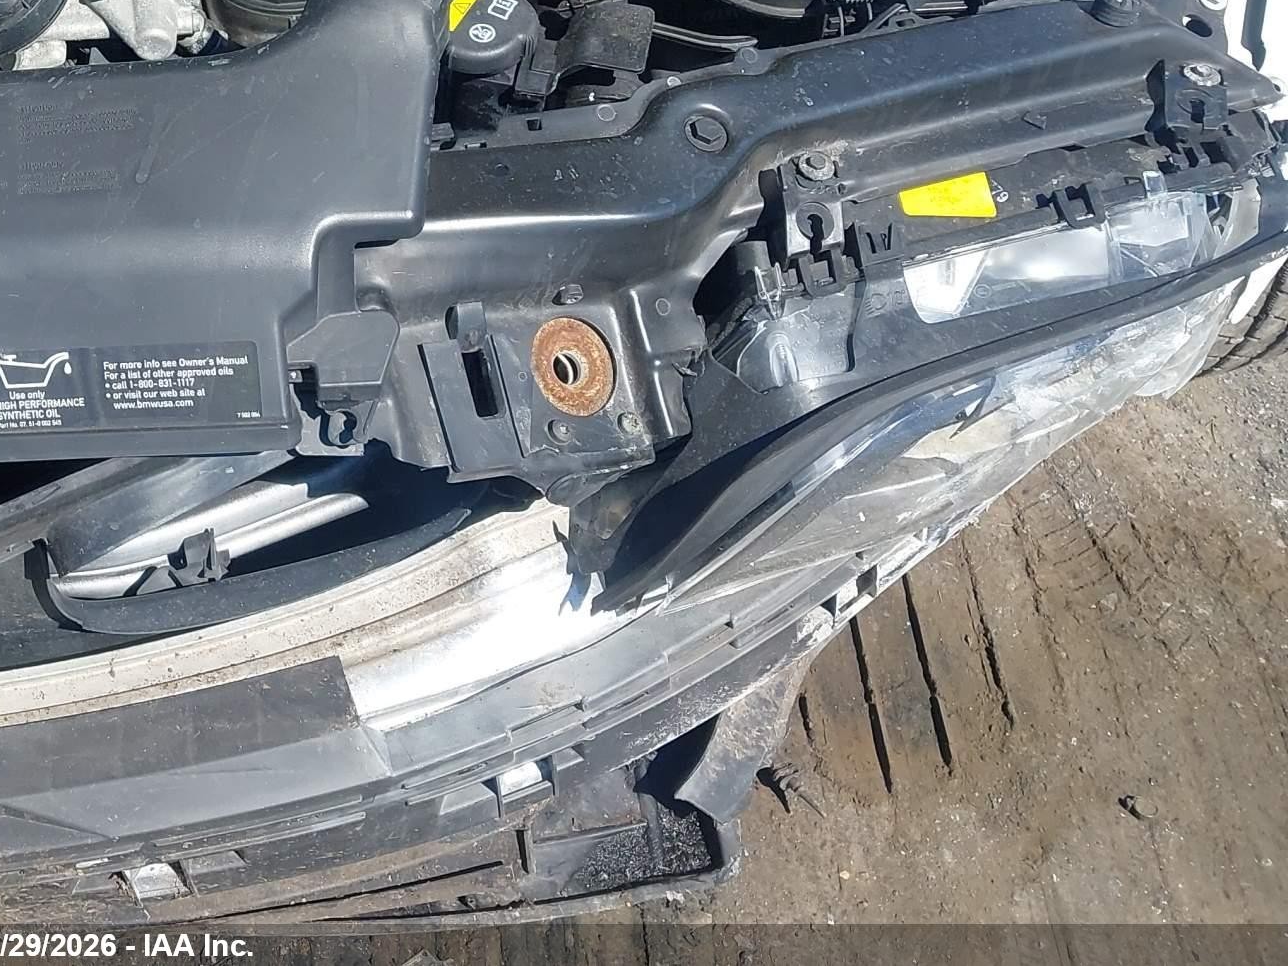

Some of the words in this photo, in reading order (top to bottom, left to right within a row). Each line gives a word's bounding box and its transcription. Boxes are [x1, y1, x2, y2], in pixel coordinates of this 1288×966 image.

[103, 361, 118, 370] For
[120, 361, 142, 369] more
[144, 359, 160, 369] info
[162, 360, 177, 368] see
[216, 355, 249, 365] Manual
[104, 371, 118, 380] For
[128, 370, 141, 379] list
[143, 369, 151, 378] of
[153, 369, 175, 378] other
[177, 366, 216, 378] approved
[218, 366, 234, 375] oils
[112, 380, 127, 389] call
[130, 378, 194, 389] 1-800-831-1117
[9, 391, 25, 400] Use
[27, 390, 45, 400] only
[113, 392, 122, 400] or
[124, 390, 142, 399] visit
[159, 389, 177, 397] web
[179, 388, 195, 397] site
[197, 388, 205, 397] at
[19, 398, 85, 409] PERFORMANCE
[113, 399, 194, 410] www.bmwusa.com
[46, 409, 61, 418] OIL
